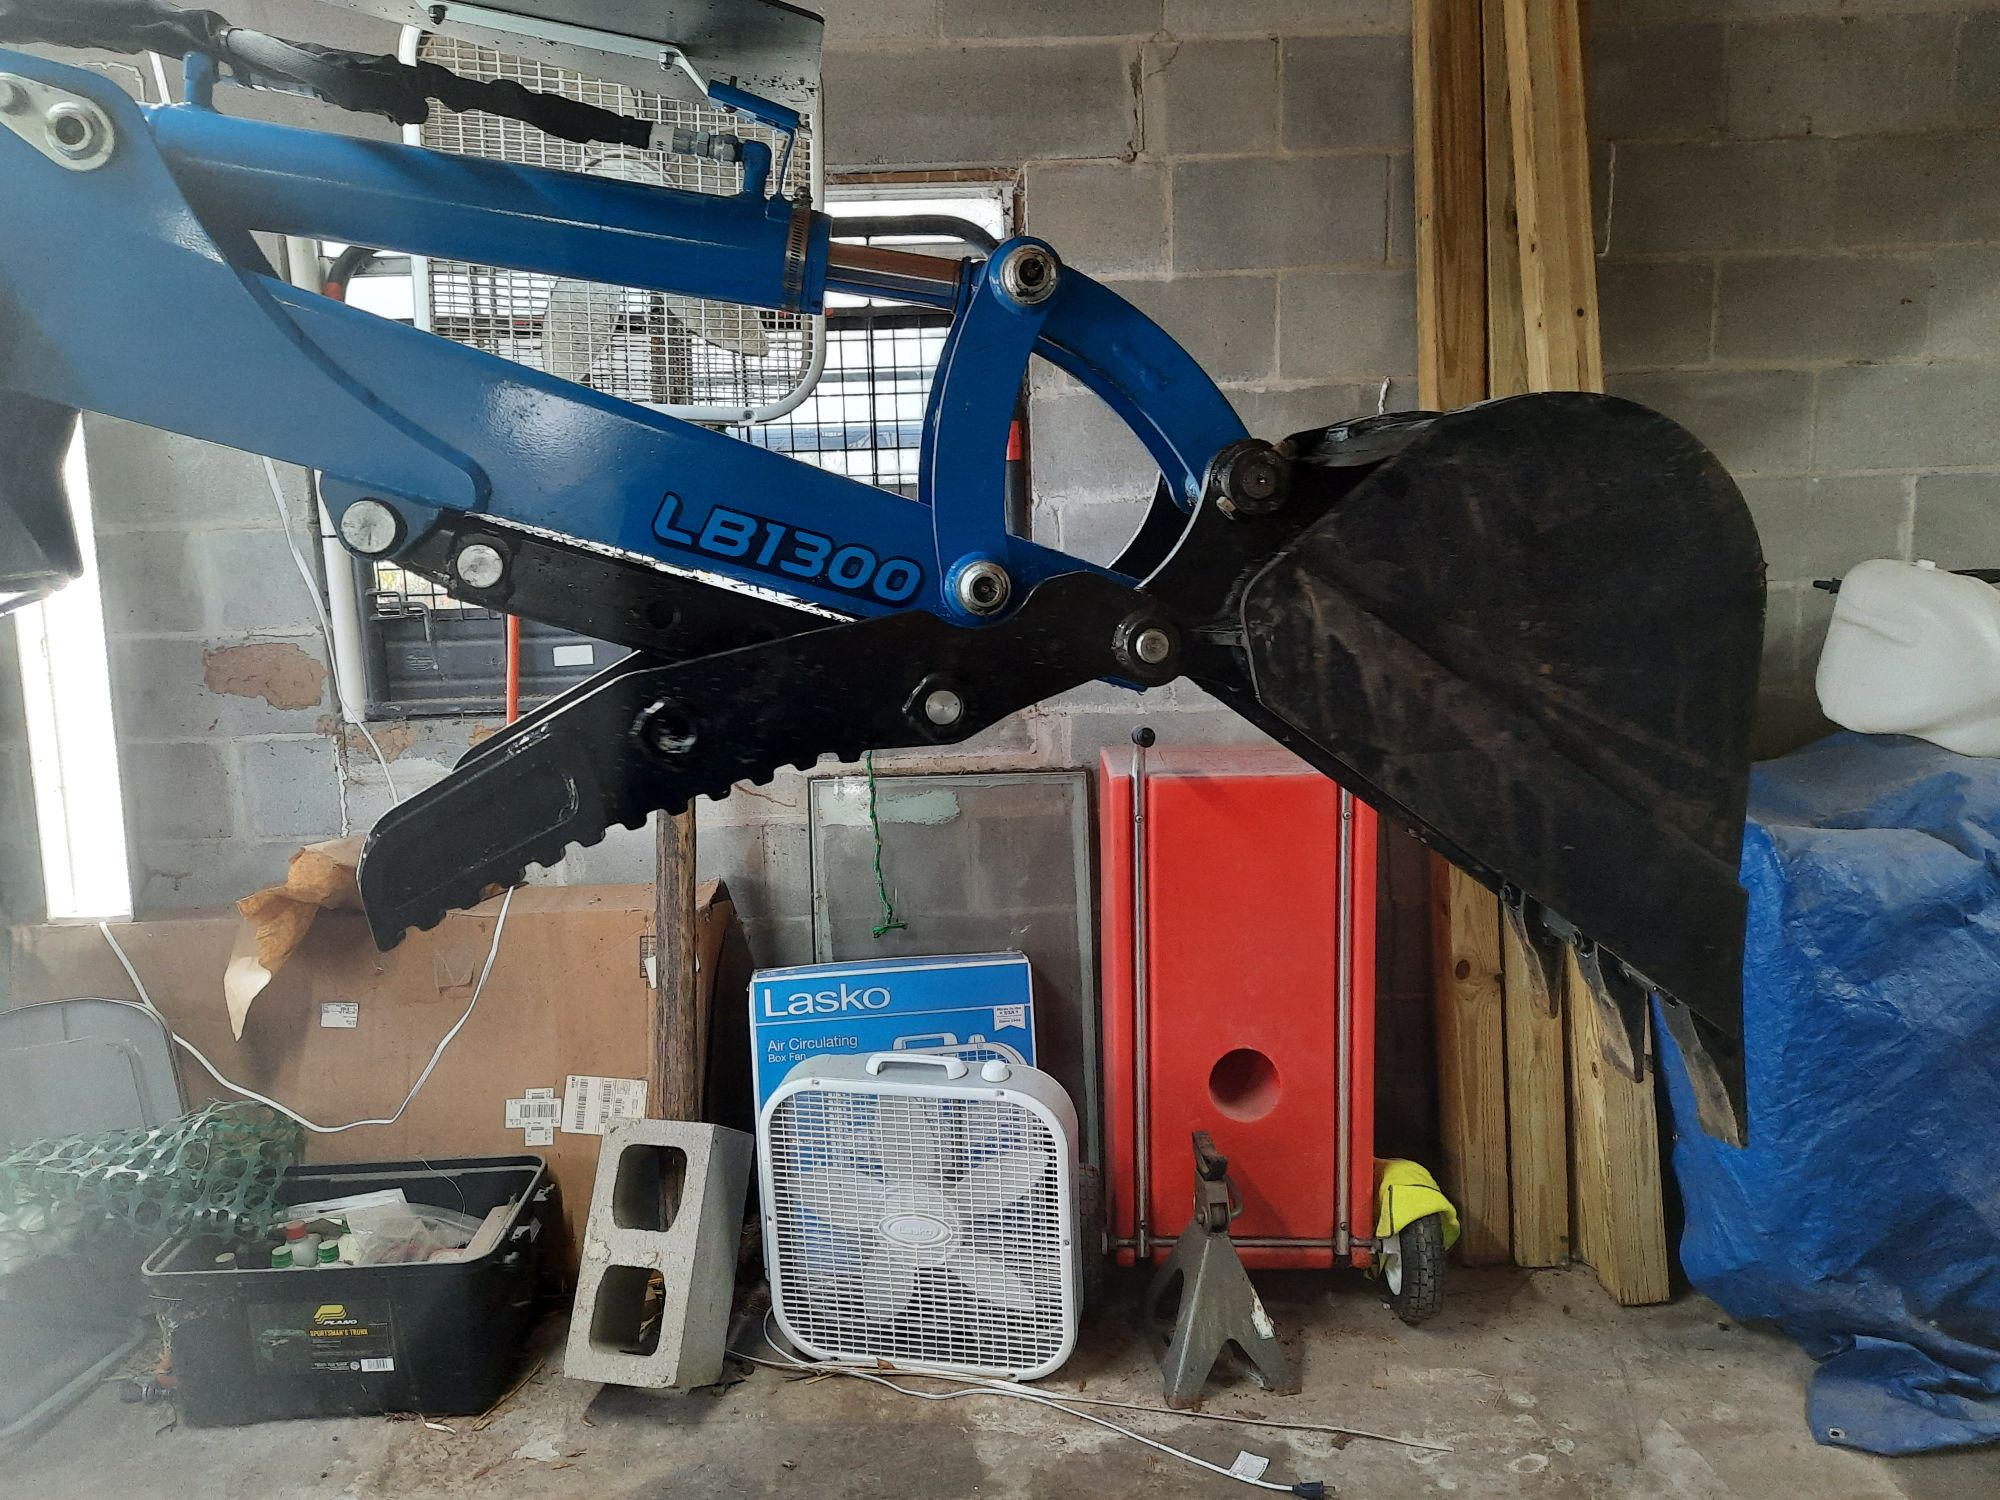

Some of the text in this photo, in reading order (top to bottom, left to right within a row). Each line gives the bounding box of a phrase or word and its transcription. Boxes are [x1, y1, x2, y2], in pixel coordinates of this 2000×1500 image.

[652, 492, 923, 603] LB1300
[764, 984, 890, 1017] Lasko
[768, 1035, 858, 1052] Air Circulating
[768, 1052, 807, 1063] Box Fan
